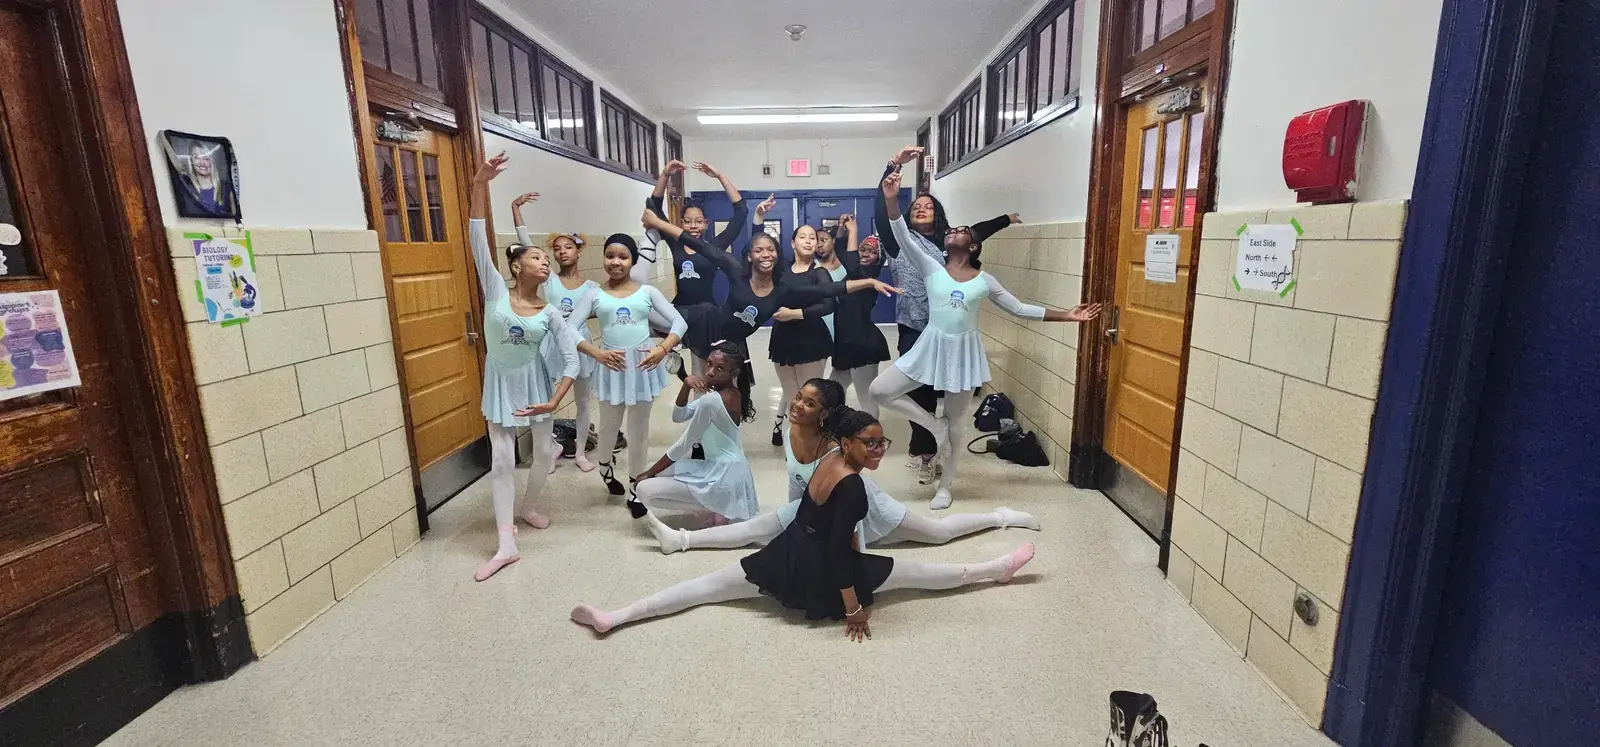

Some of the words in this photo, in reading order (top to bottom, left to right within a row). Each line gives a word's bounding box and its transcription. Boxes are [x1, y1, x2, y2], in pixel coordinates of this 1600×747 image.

[1250, 239, 1262, 247] East
[1263, 239, 1276, 248] Side
[202, 246, 228, 254] BIOLOGY
[204, 254, 234, 262] TUTORING
[1245, 253, 1262, 262] North
[1260, 269, 1278, 278] South
